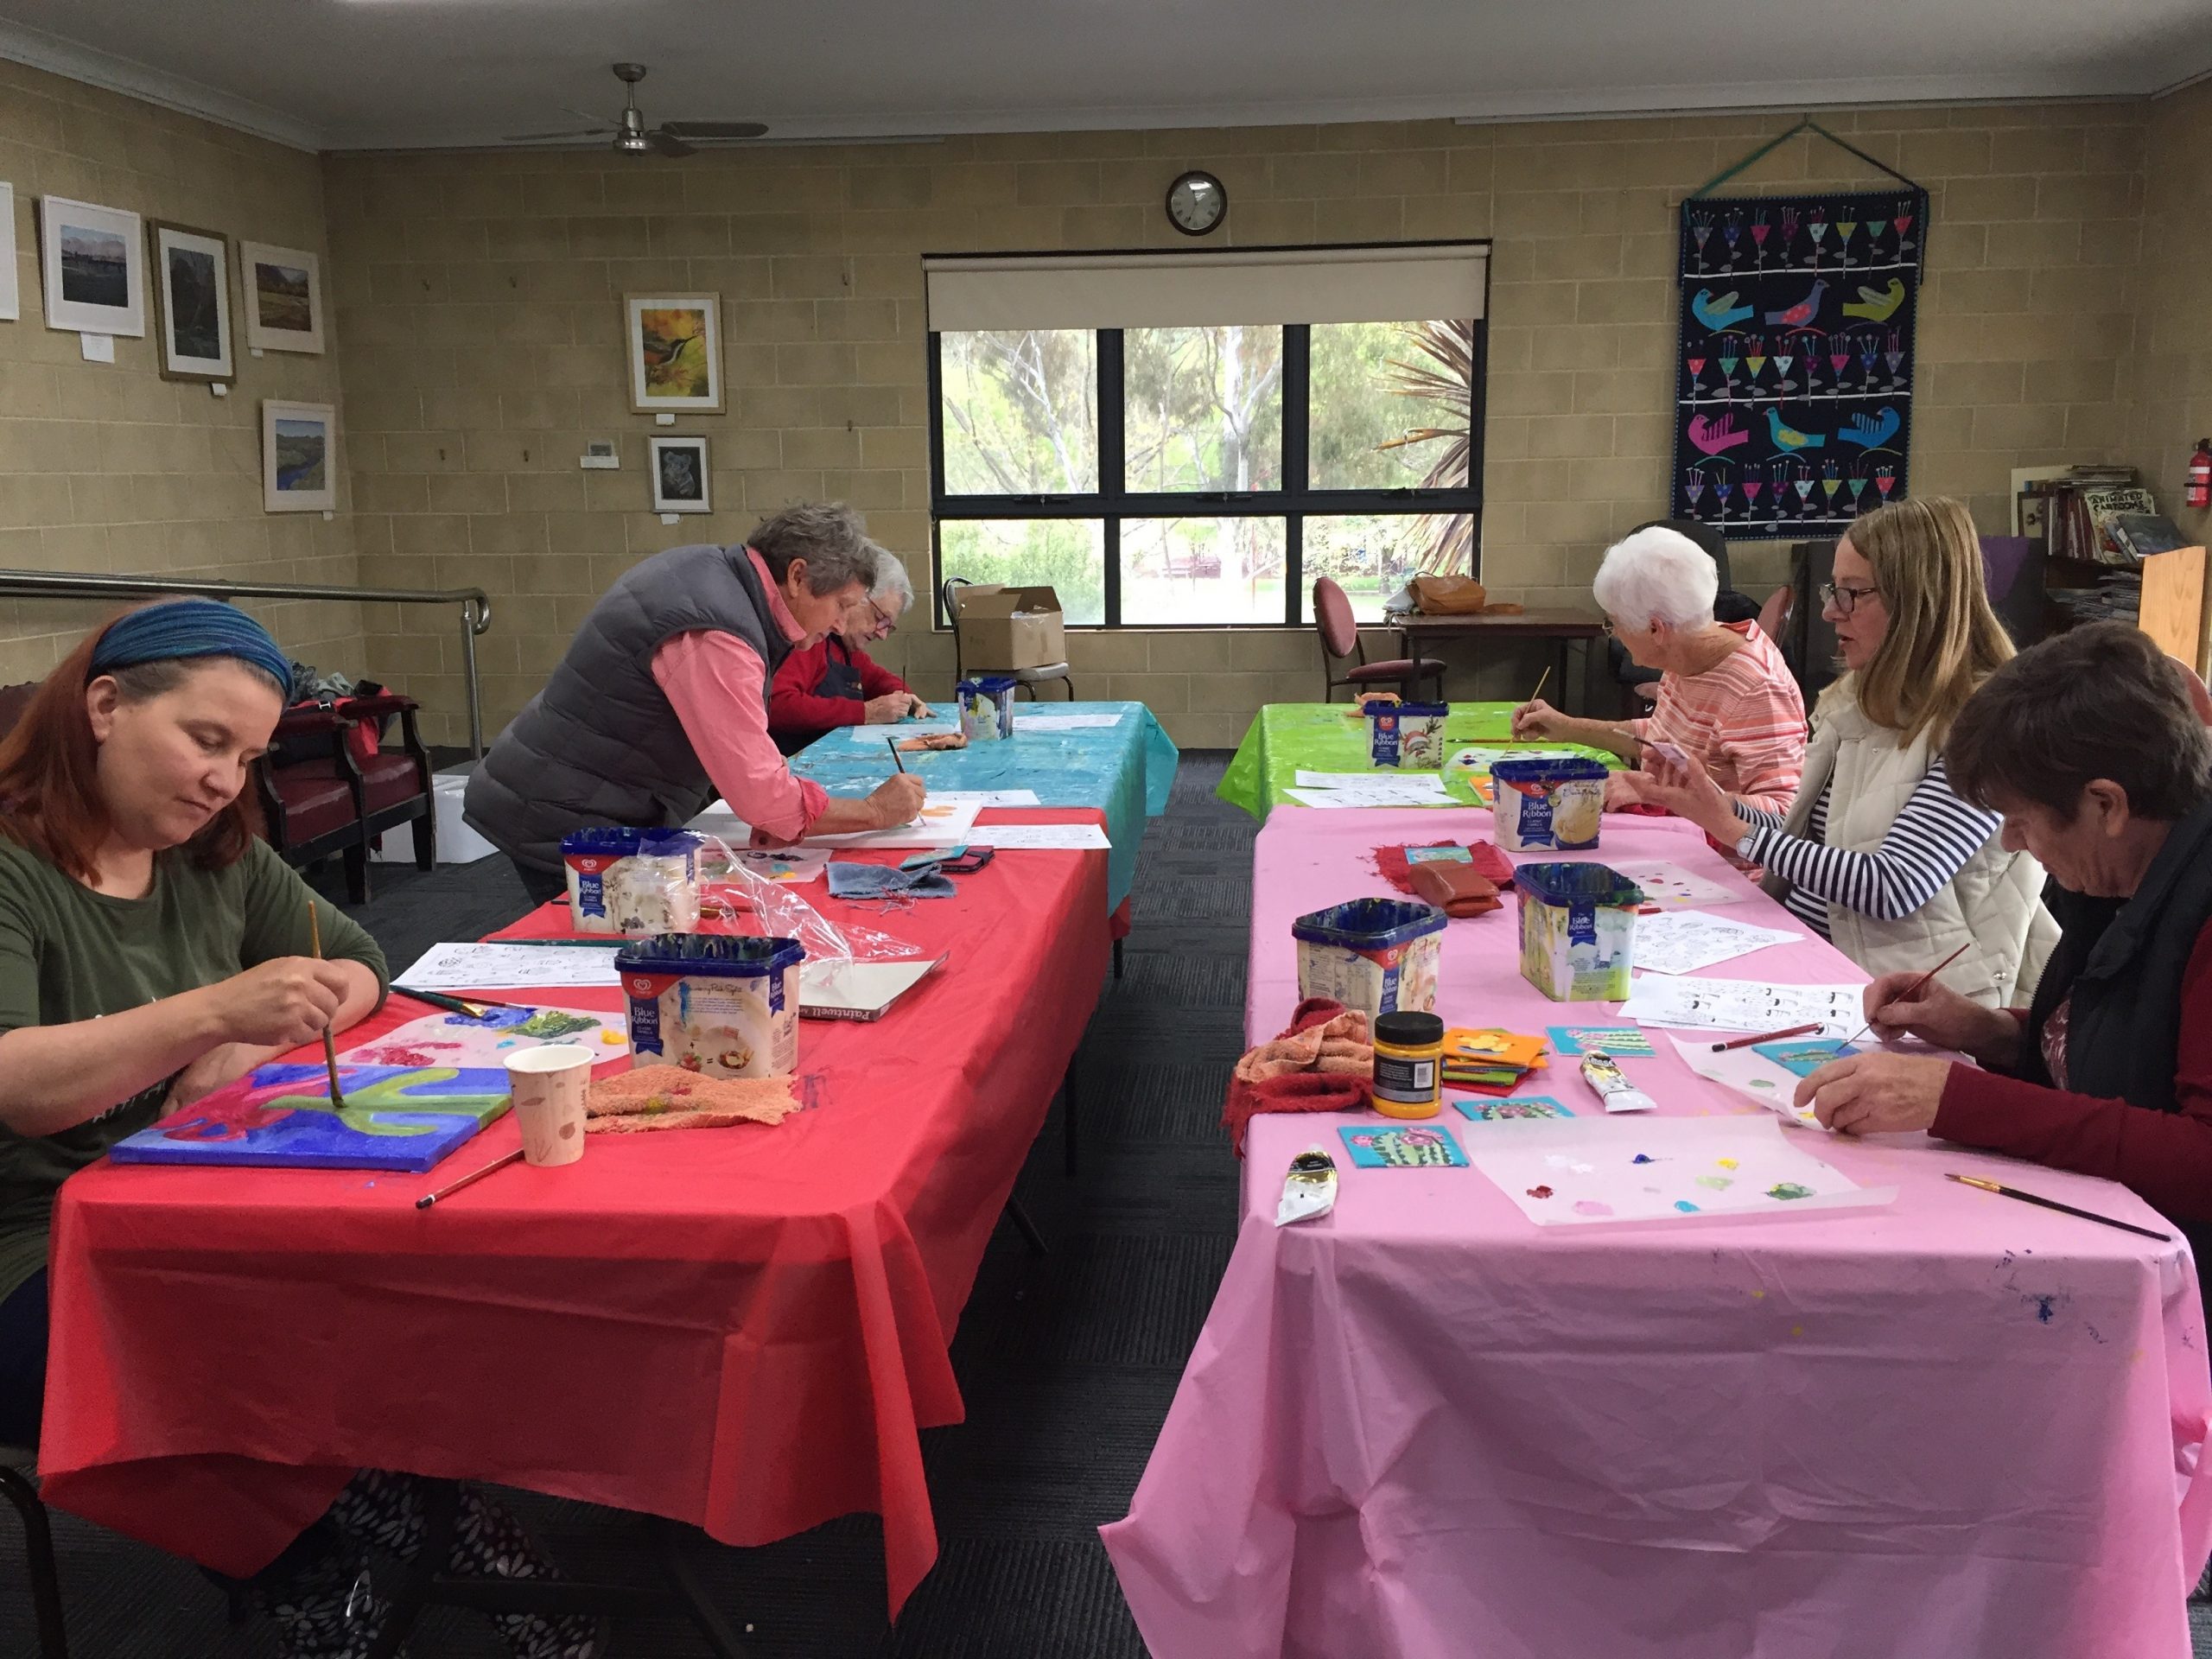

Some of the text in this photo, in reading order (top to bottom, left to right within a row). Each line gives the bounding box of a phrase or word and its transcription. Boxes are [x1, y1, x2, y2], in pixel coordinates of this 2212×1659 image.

[2092, 491, 2143, 504] ANIMATED
[2093, 500, 2145, 512] CARTOONS
[1528, 802, 1548, 810] Blue
[582, 880, 600, 888] Blue
[634, 1007, 655, 1017] Blue
[812, 1007, 870, 1020] Paintwell
[632, 1016, 658, 1026] Ribbon
